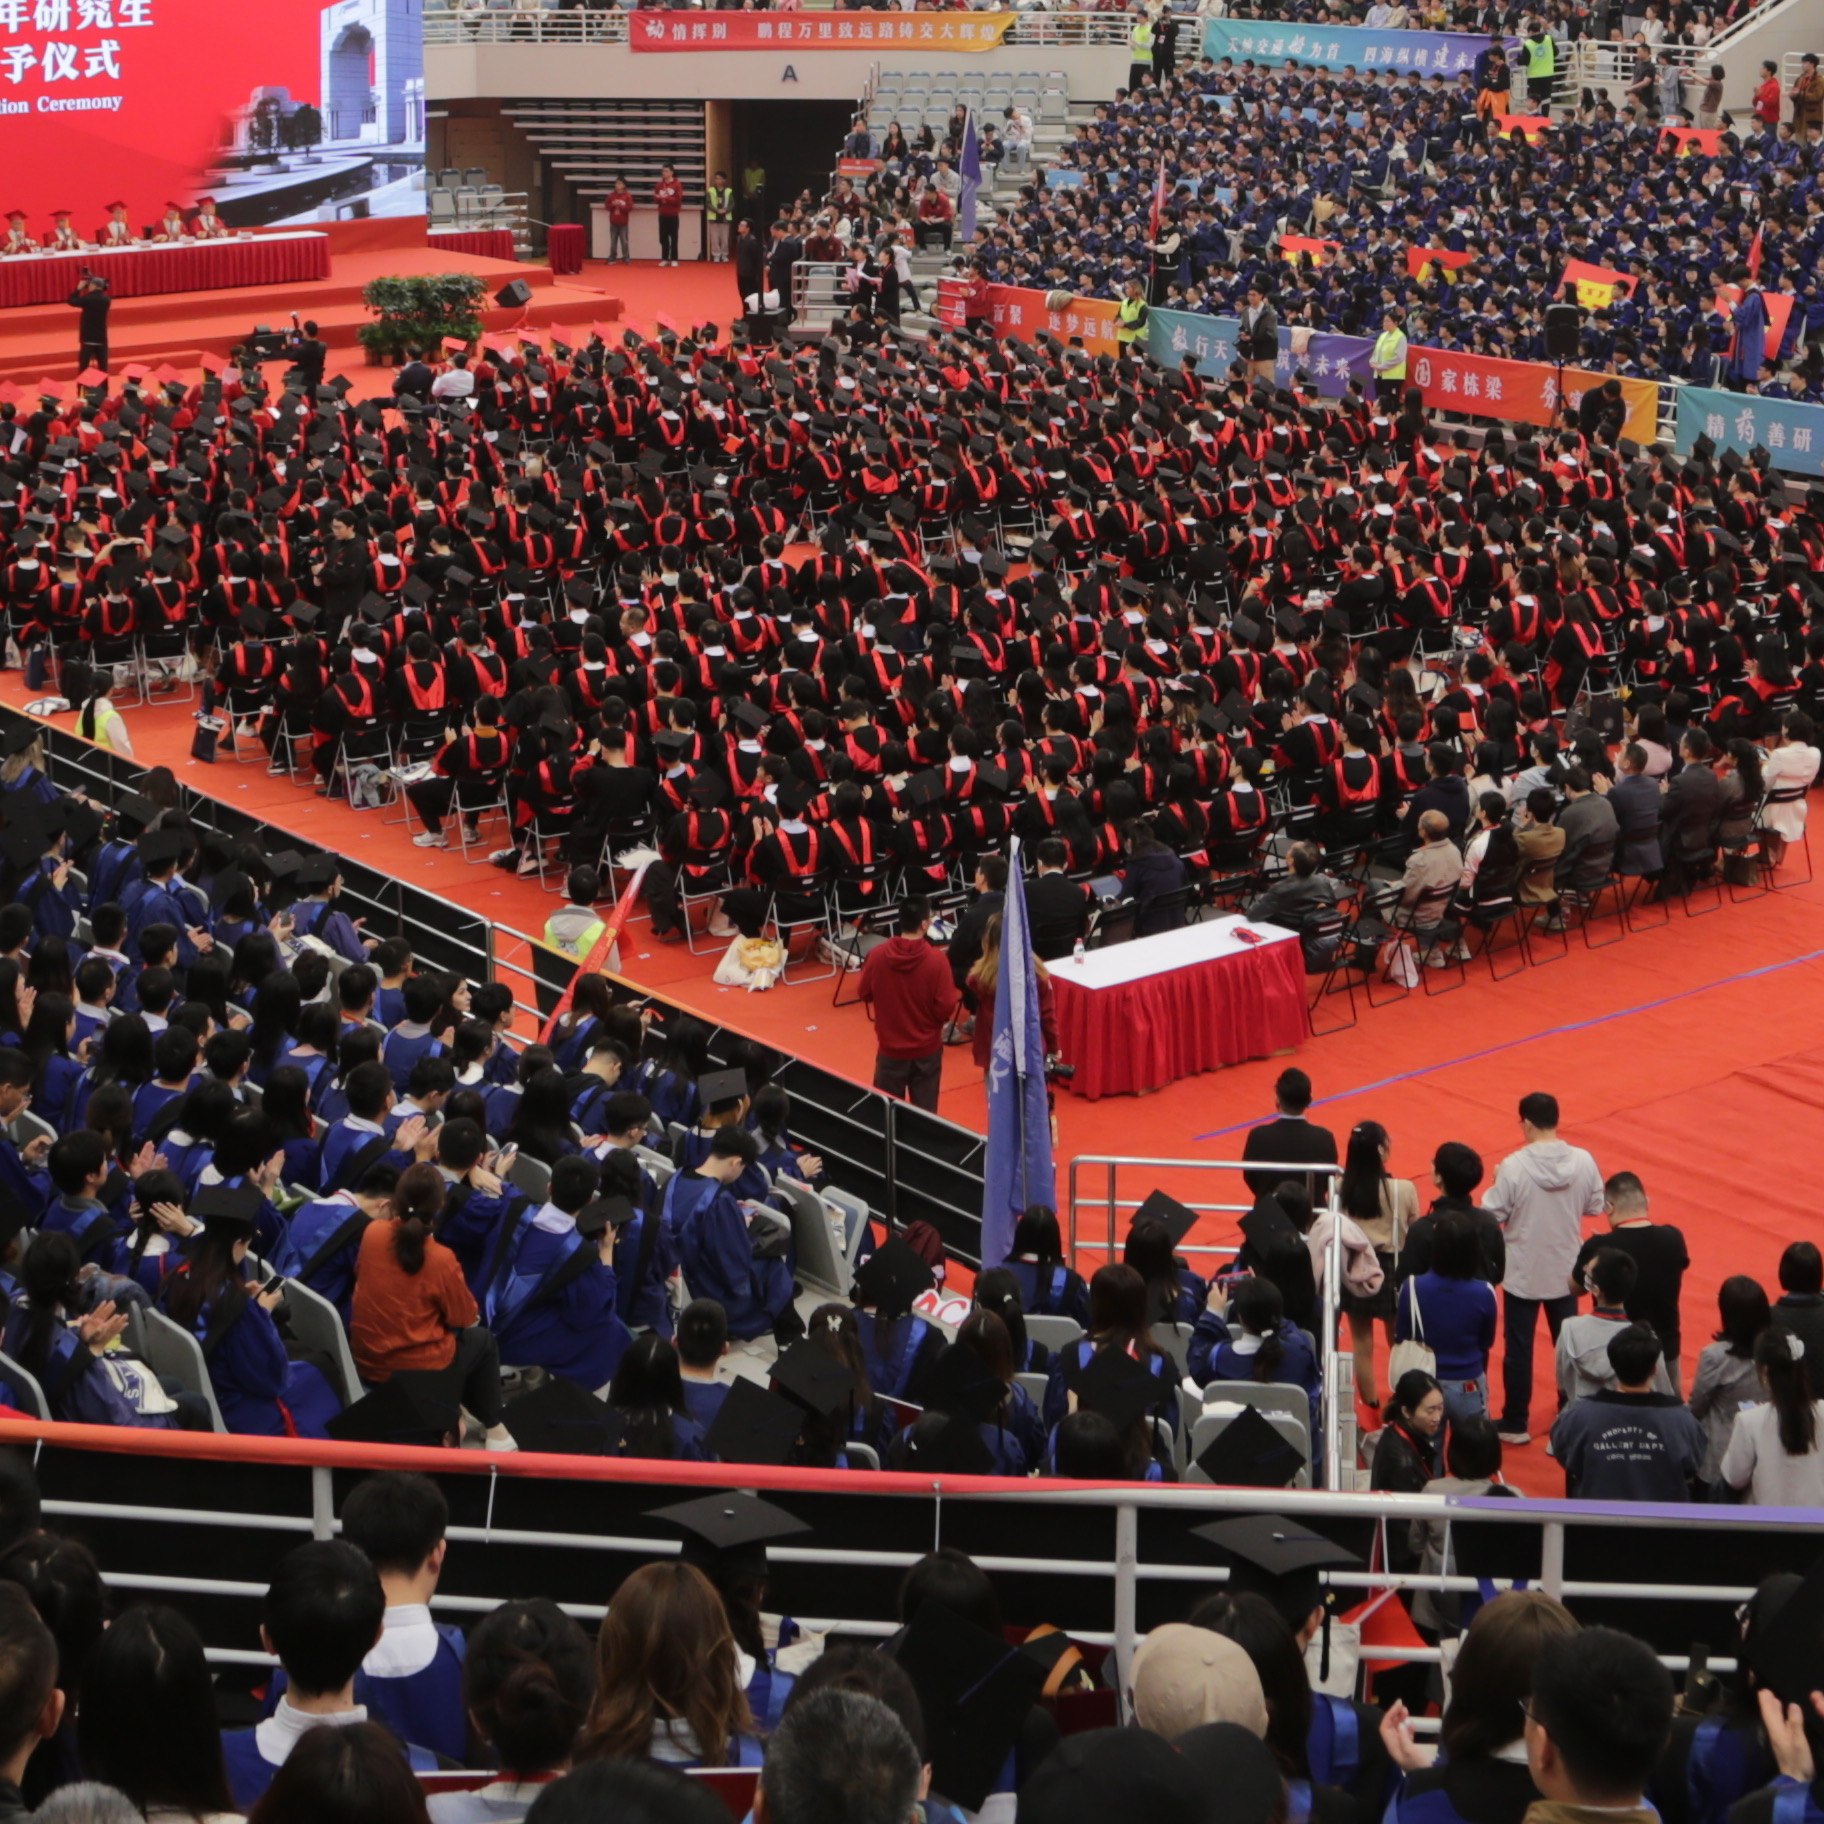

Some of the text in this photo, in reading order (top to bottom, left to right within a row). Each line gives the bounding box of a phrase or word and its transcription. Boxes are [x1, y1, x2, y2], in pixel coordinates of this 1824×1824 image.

[645, 18, 727, 41] 动情挥别
[1363, 42, 1476, 70] 四海纵横建未
[781, 64, 799, 83] A
[36, 93, 123, 118] Ceremony
[1171, 324, 1229, 361] 数行天
[1414, 357, 1503, 401] 国家栋梁
